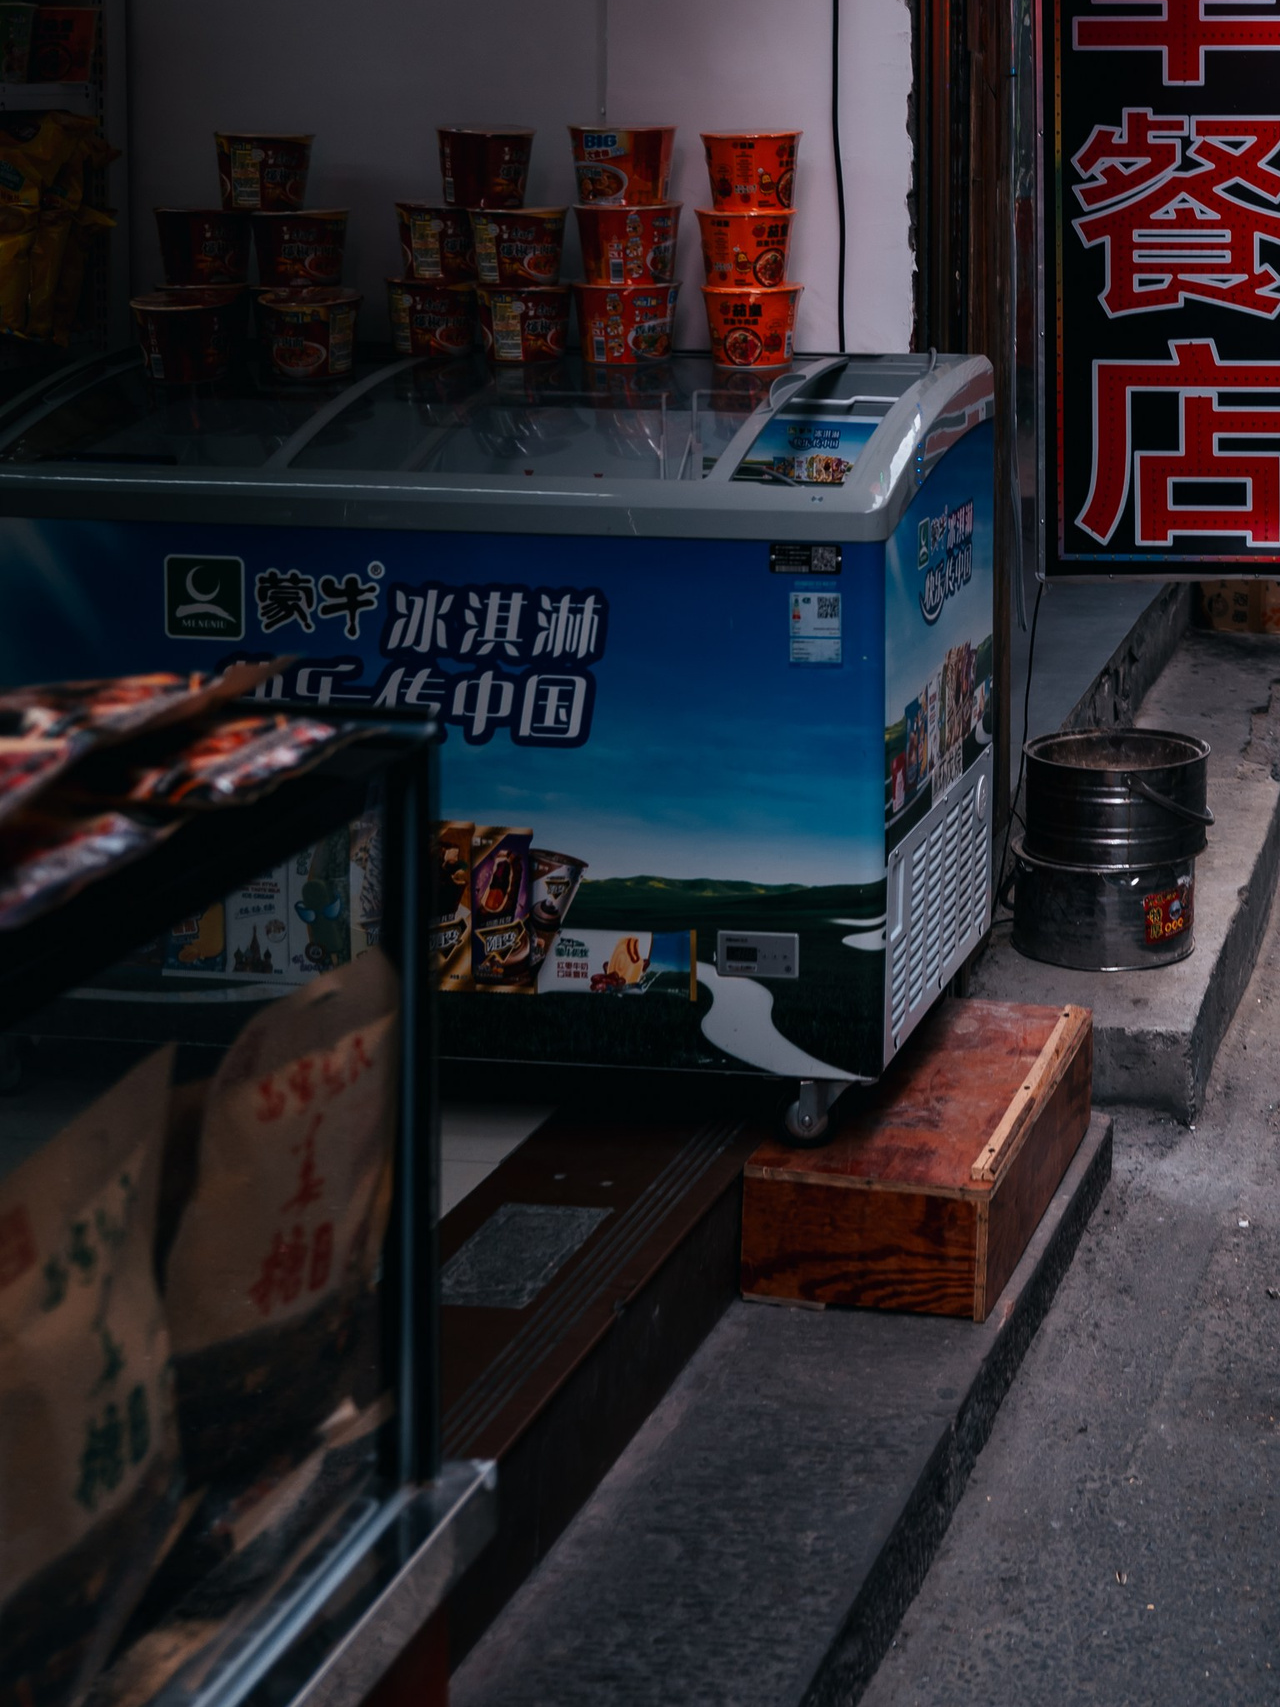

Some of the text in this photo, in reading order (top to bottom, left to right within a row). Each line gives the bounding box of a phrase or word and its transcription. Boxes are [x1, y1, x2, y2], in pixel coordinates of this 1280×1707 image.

[583, 133, 618, 149] BIG
[181, 618, 227, 630] MENGNIU
[256, 569, 379, 639] 蒙牛
[386, 589, 602, 659] 冰淇淋
